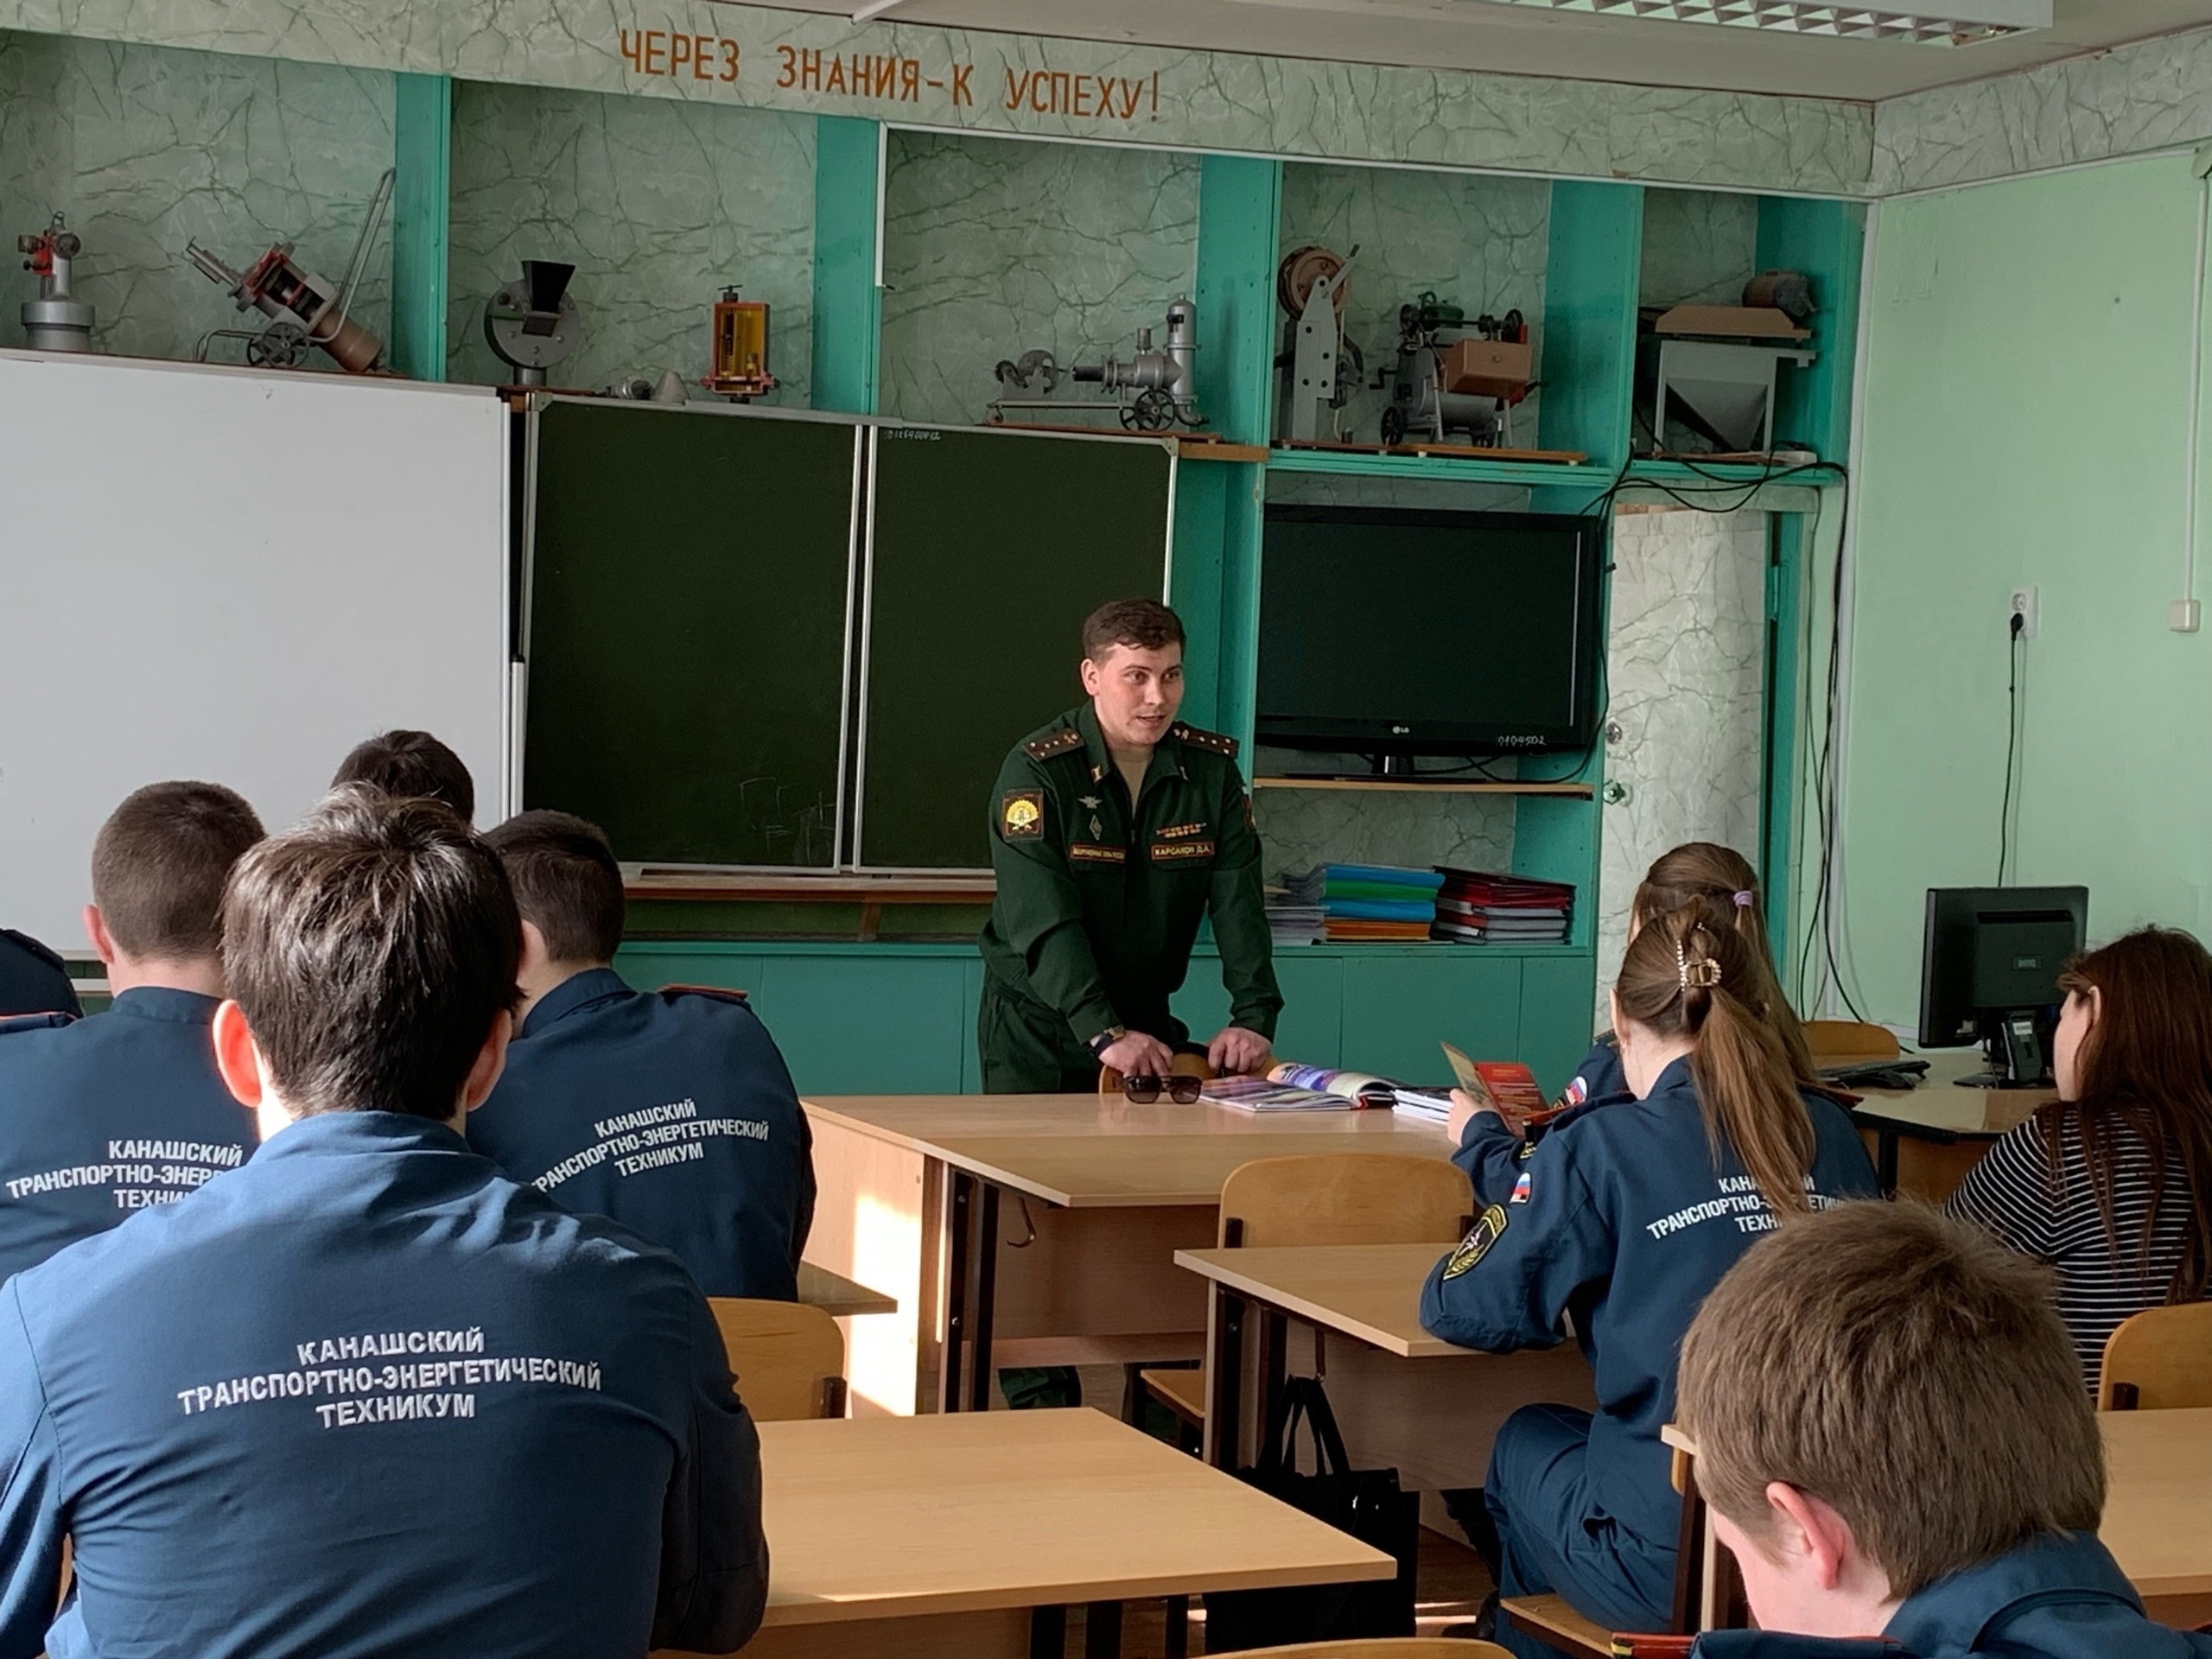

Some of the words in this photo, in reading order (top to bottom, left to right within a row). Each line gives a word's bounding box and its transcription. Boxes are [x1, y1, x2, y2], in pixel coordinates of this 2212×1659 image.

[620, 29, 741, 82] ЧЕРЕЗ
[1006, 69, 1159, 122] УСПЕХУ!
[594, 1097, 697, 1138] КАНАШСКИЙ
[109, 1140, 243, 1166] КАНАШСКИЙ
[531, 1118, 769, 1193] РАНСПОРТНО-ЭНЕРГЕТИЧЕСКИЙ
[614, 1141, 703, 1177] ТЕХНИКУМ
[6, 1164, 225, 1198] ТРАНСПОРТНО-ЭНЕР
[113, 1189, 192, 1209] ТЕХНИ
[1734, 1213, 1783, 1233] ТЕХН
[296, 1326, 485, 1366] КАНАШСКИЙ
[177, 1357, 601, 1415] ТРАНСПОРТНО-ЭНЕРГЕТИЧЕСКИЙ
[316, 1393, 475, 1429] ТЕХНИКУМ
